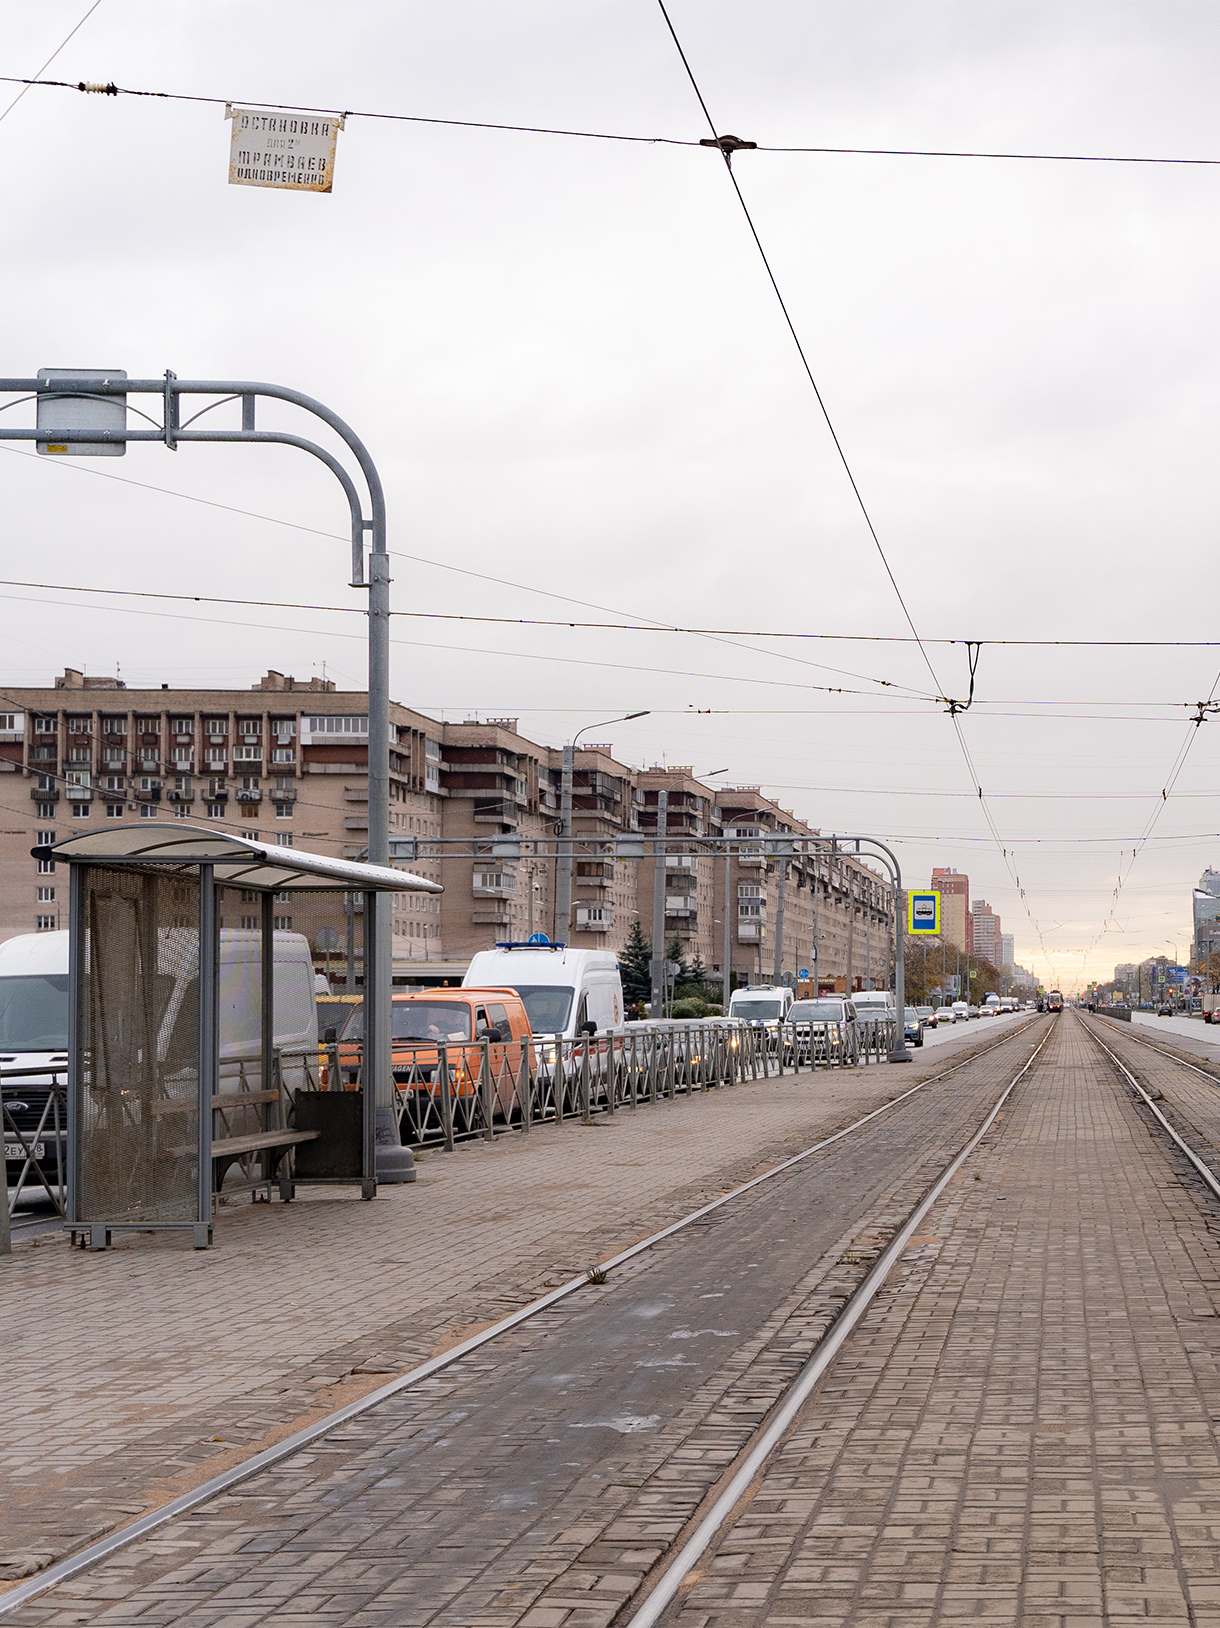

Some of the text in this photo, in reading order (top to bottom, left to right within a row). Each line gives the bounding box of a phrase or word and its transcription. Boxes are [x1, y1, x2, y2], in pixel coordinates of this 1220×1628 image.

[240, 115, 330, 136] ОСТАНОВКА
[238, 150, 327, 171] ТРАМВАЕВ
[237, 168, 325, 185] ОДНОВРЕМЕННО
[6, 1103, 21, 1111] Ford
